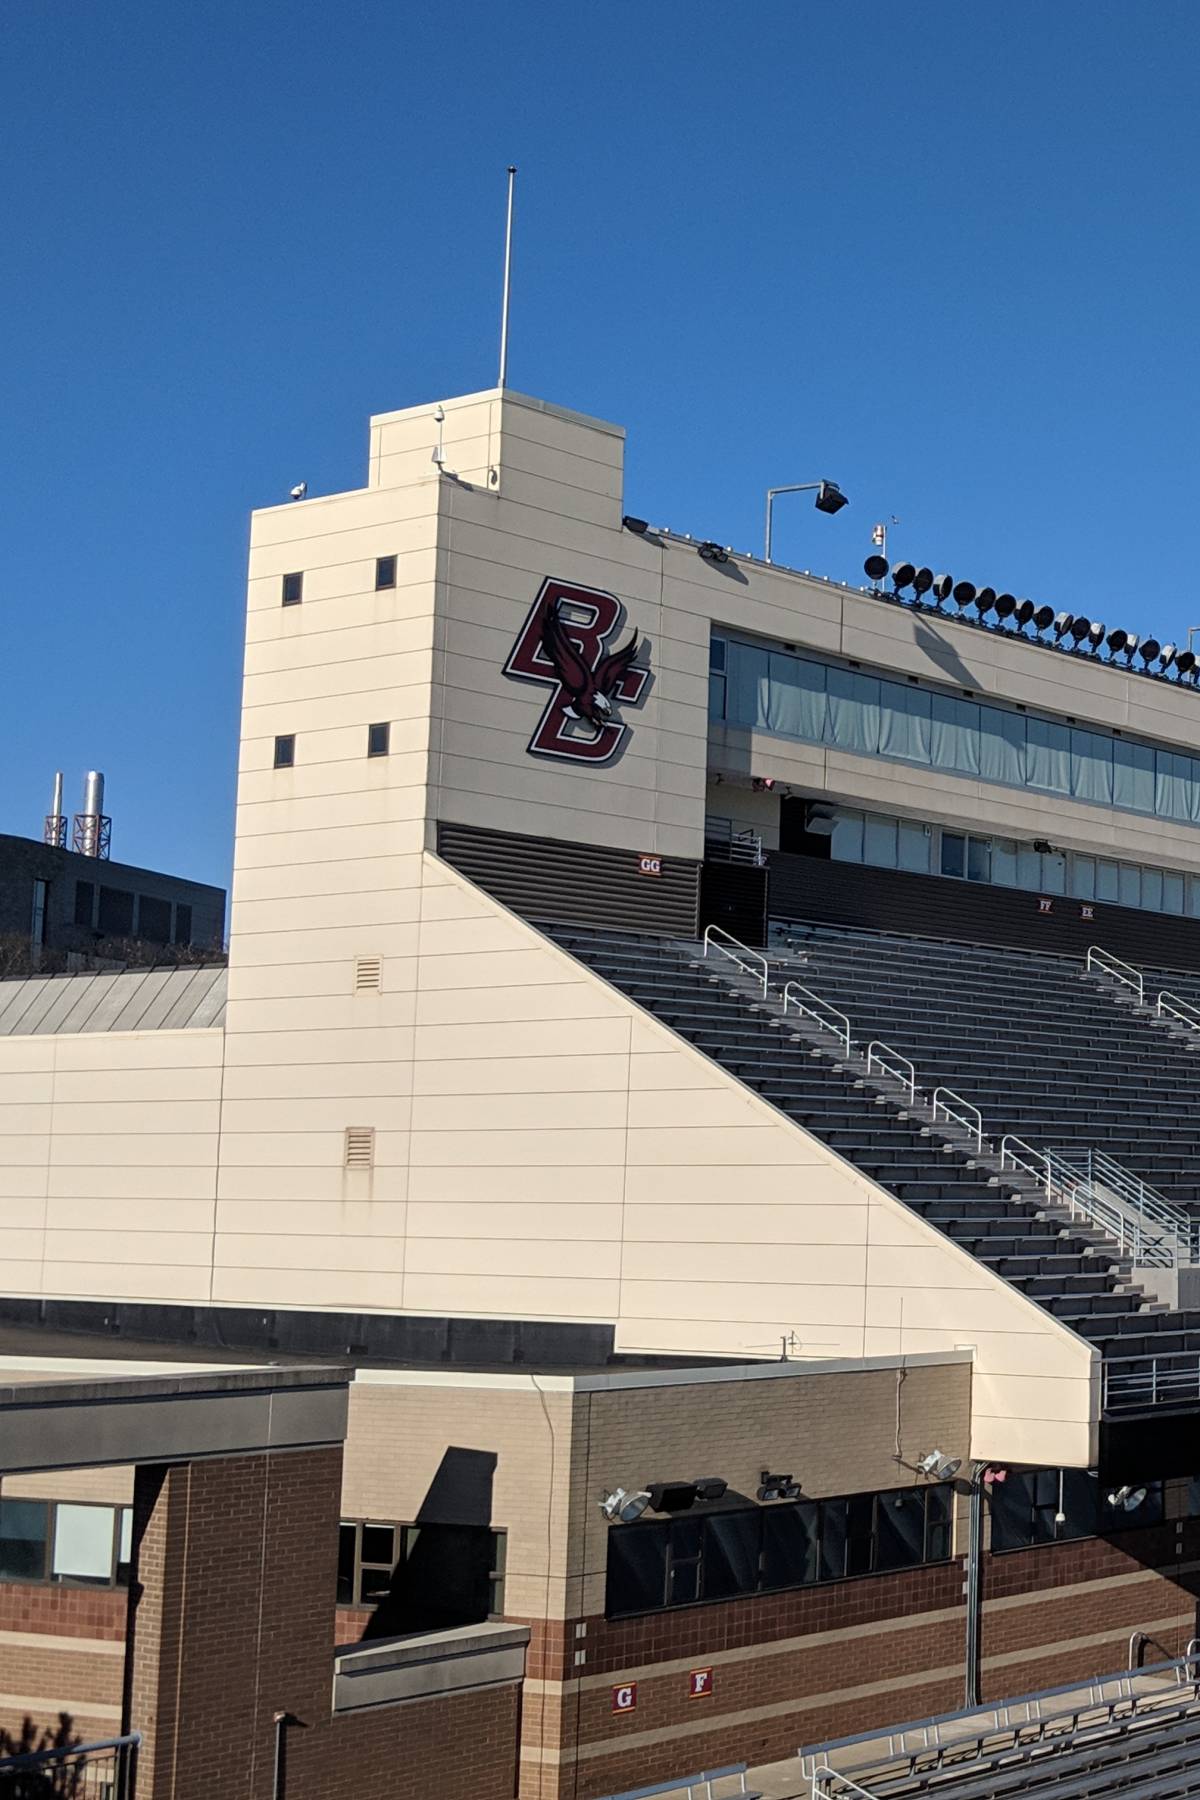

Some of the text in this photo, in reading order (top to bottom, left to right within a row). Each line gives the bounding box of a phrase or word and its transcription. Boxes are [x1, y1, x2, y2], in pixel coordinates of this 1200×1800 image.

[641, 858, 660, 872] GG
[694, 1672, 708, 1693] F
[617, 1687, 633, 1708] G
